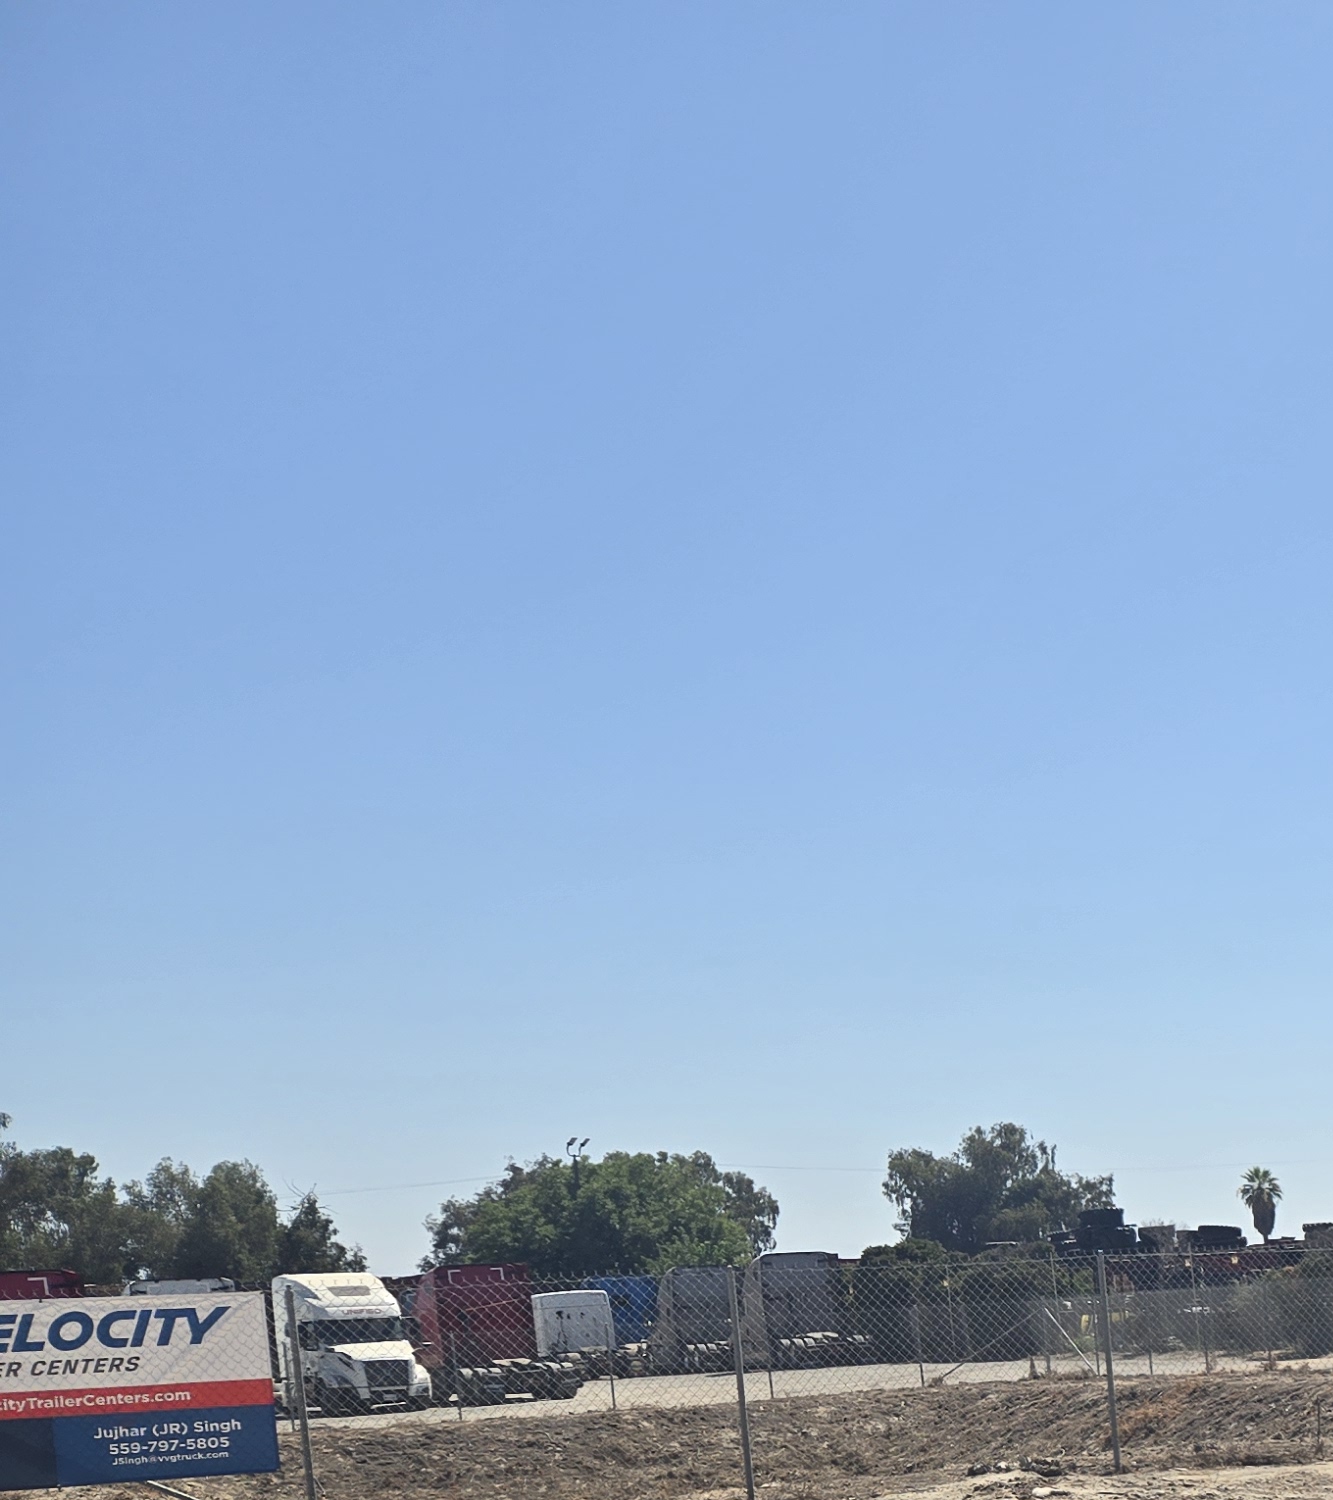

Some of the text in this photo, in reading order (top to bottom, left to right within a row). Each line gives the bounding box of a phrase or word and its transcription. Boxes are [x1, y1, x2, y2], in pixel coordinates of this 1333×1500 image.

[30, 1356, 140, 1376] CENTERS
[0, 1390, 191, 1413] ityTrailerCenters.com
[93, 1419, 242, 1440] Jujhar (JR) Singh
[109, 1436, 230, 1455] 559-797-5805
